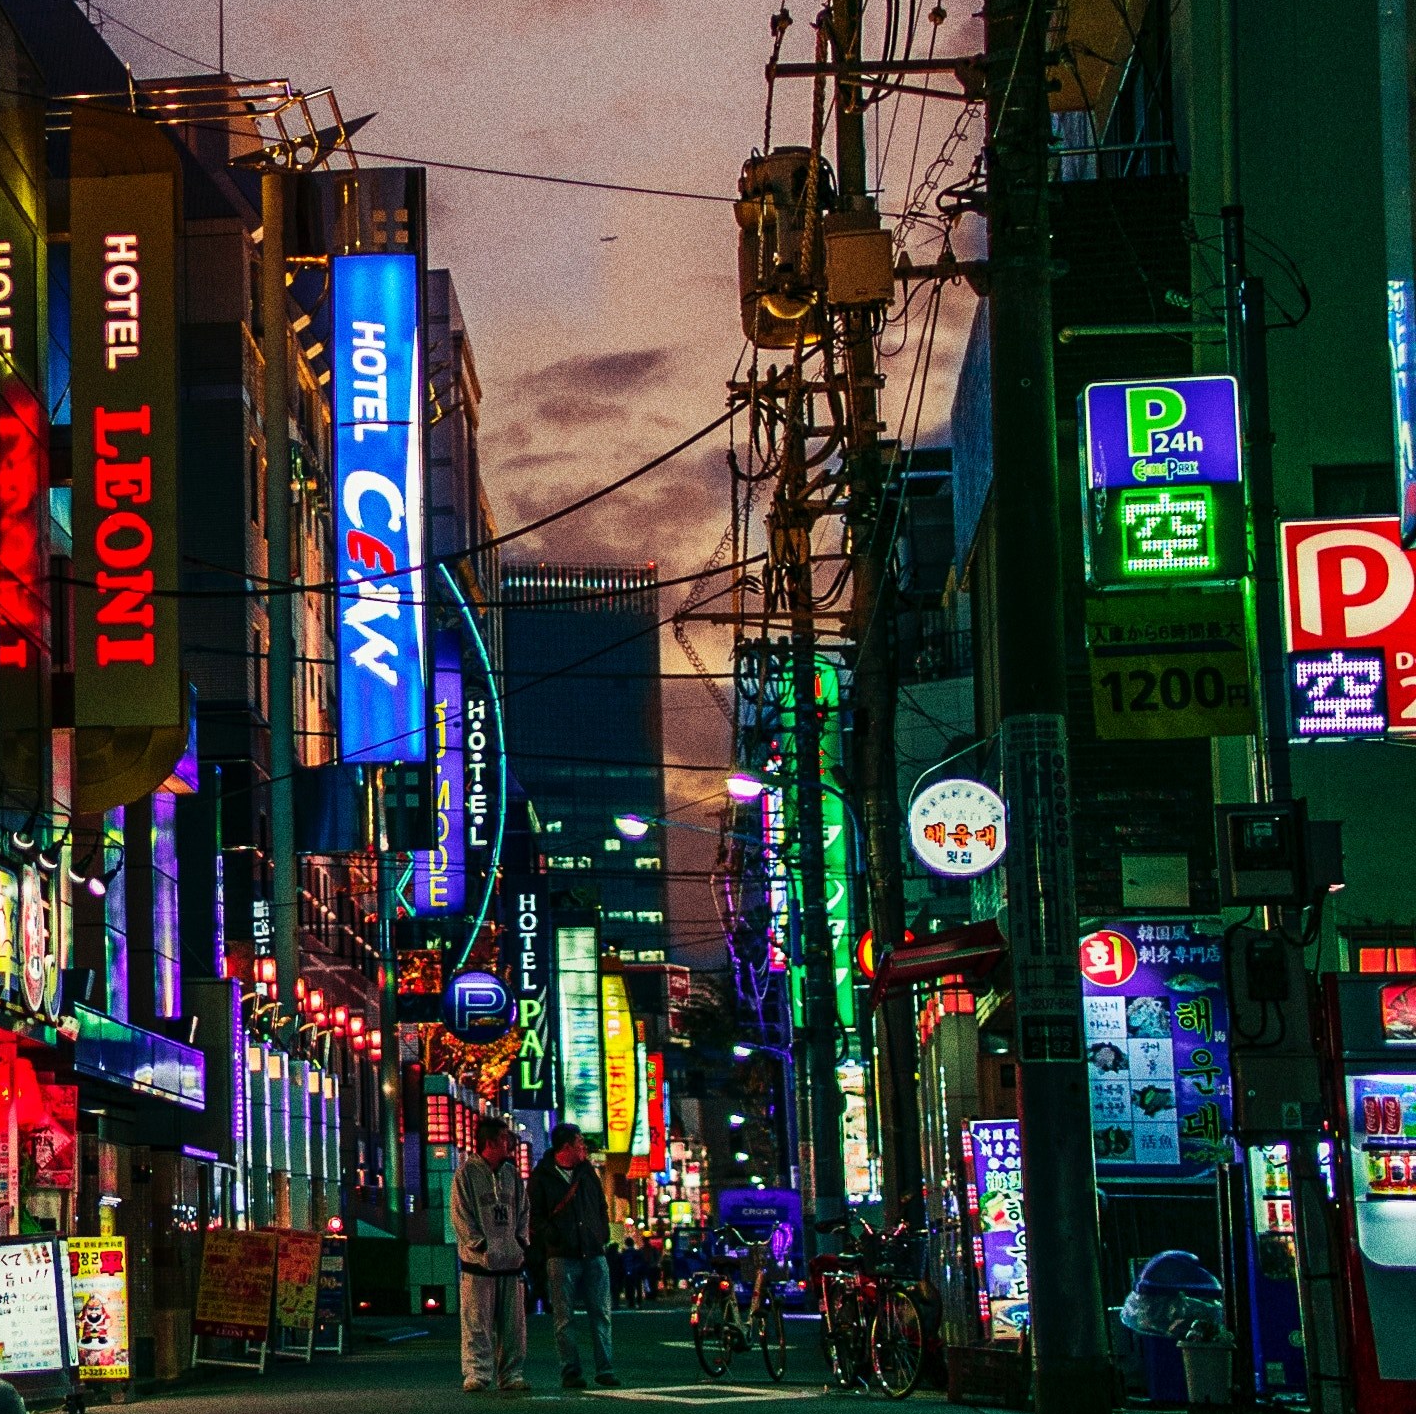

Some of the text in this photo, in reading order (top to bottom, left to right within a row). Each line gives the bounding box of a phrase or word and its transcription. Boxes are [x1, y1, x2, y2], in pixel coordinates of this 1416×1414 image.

[351, 321, 389, 442] HOTEL
[1125, 386, 1187, 457] P
[95, 235, 155, 665] HOTEL LEONI
[1154, 430, 1203, 453] 24h
[1125, 492, 1209, 572] 空
[1296, 529, 1415, 637] P
[1100, 667, 1249, 712] 1200円
[1297, 650, 1384, 734] 空
[1137, 924, 1190, 942] 韓国風
[1138, 945, 1221, 964] 刺身専門店
[453, 982, 508, 1031] P
[519, 893, 545, 1089] HOTEL PAL
[1174, 996, 1224, 1146] 해운대
